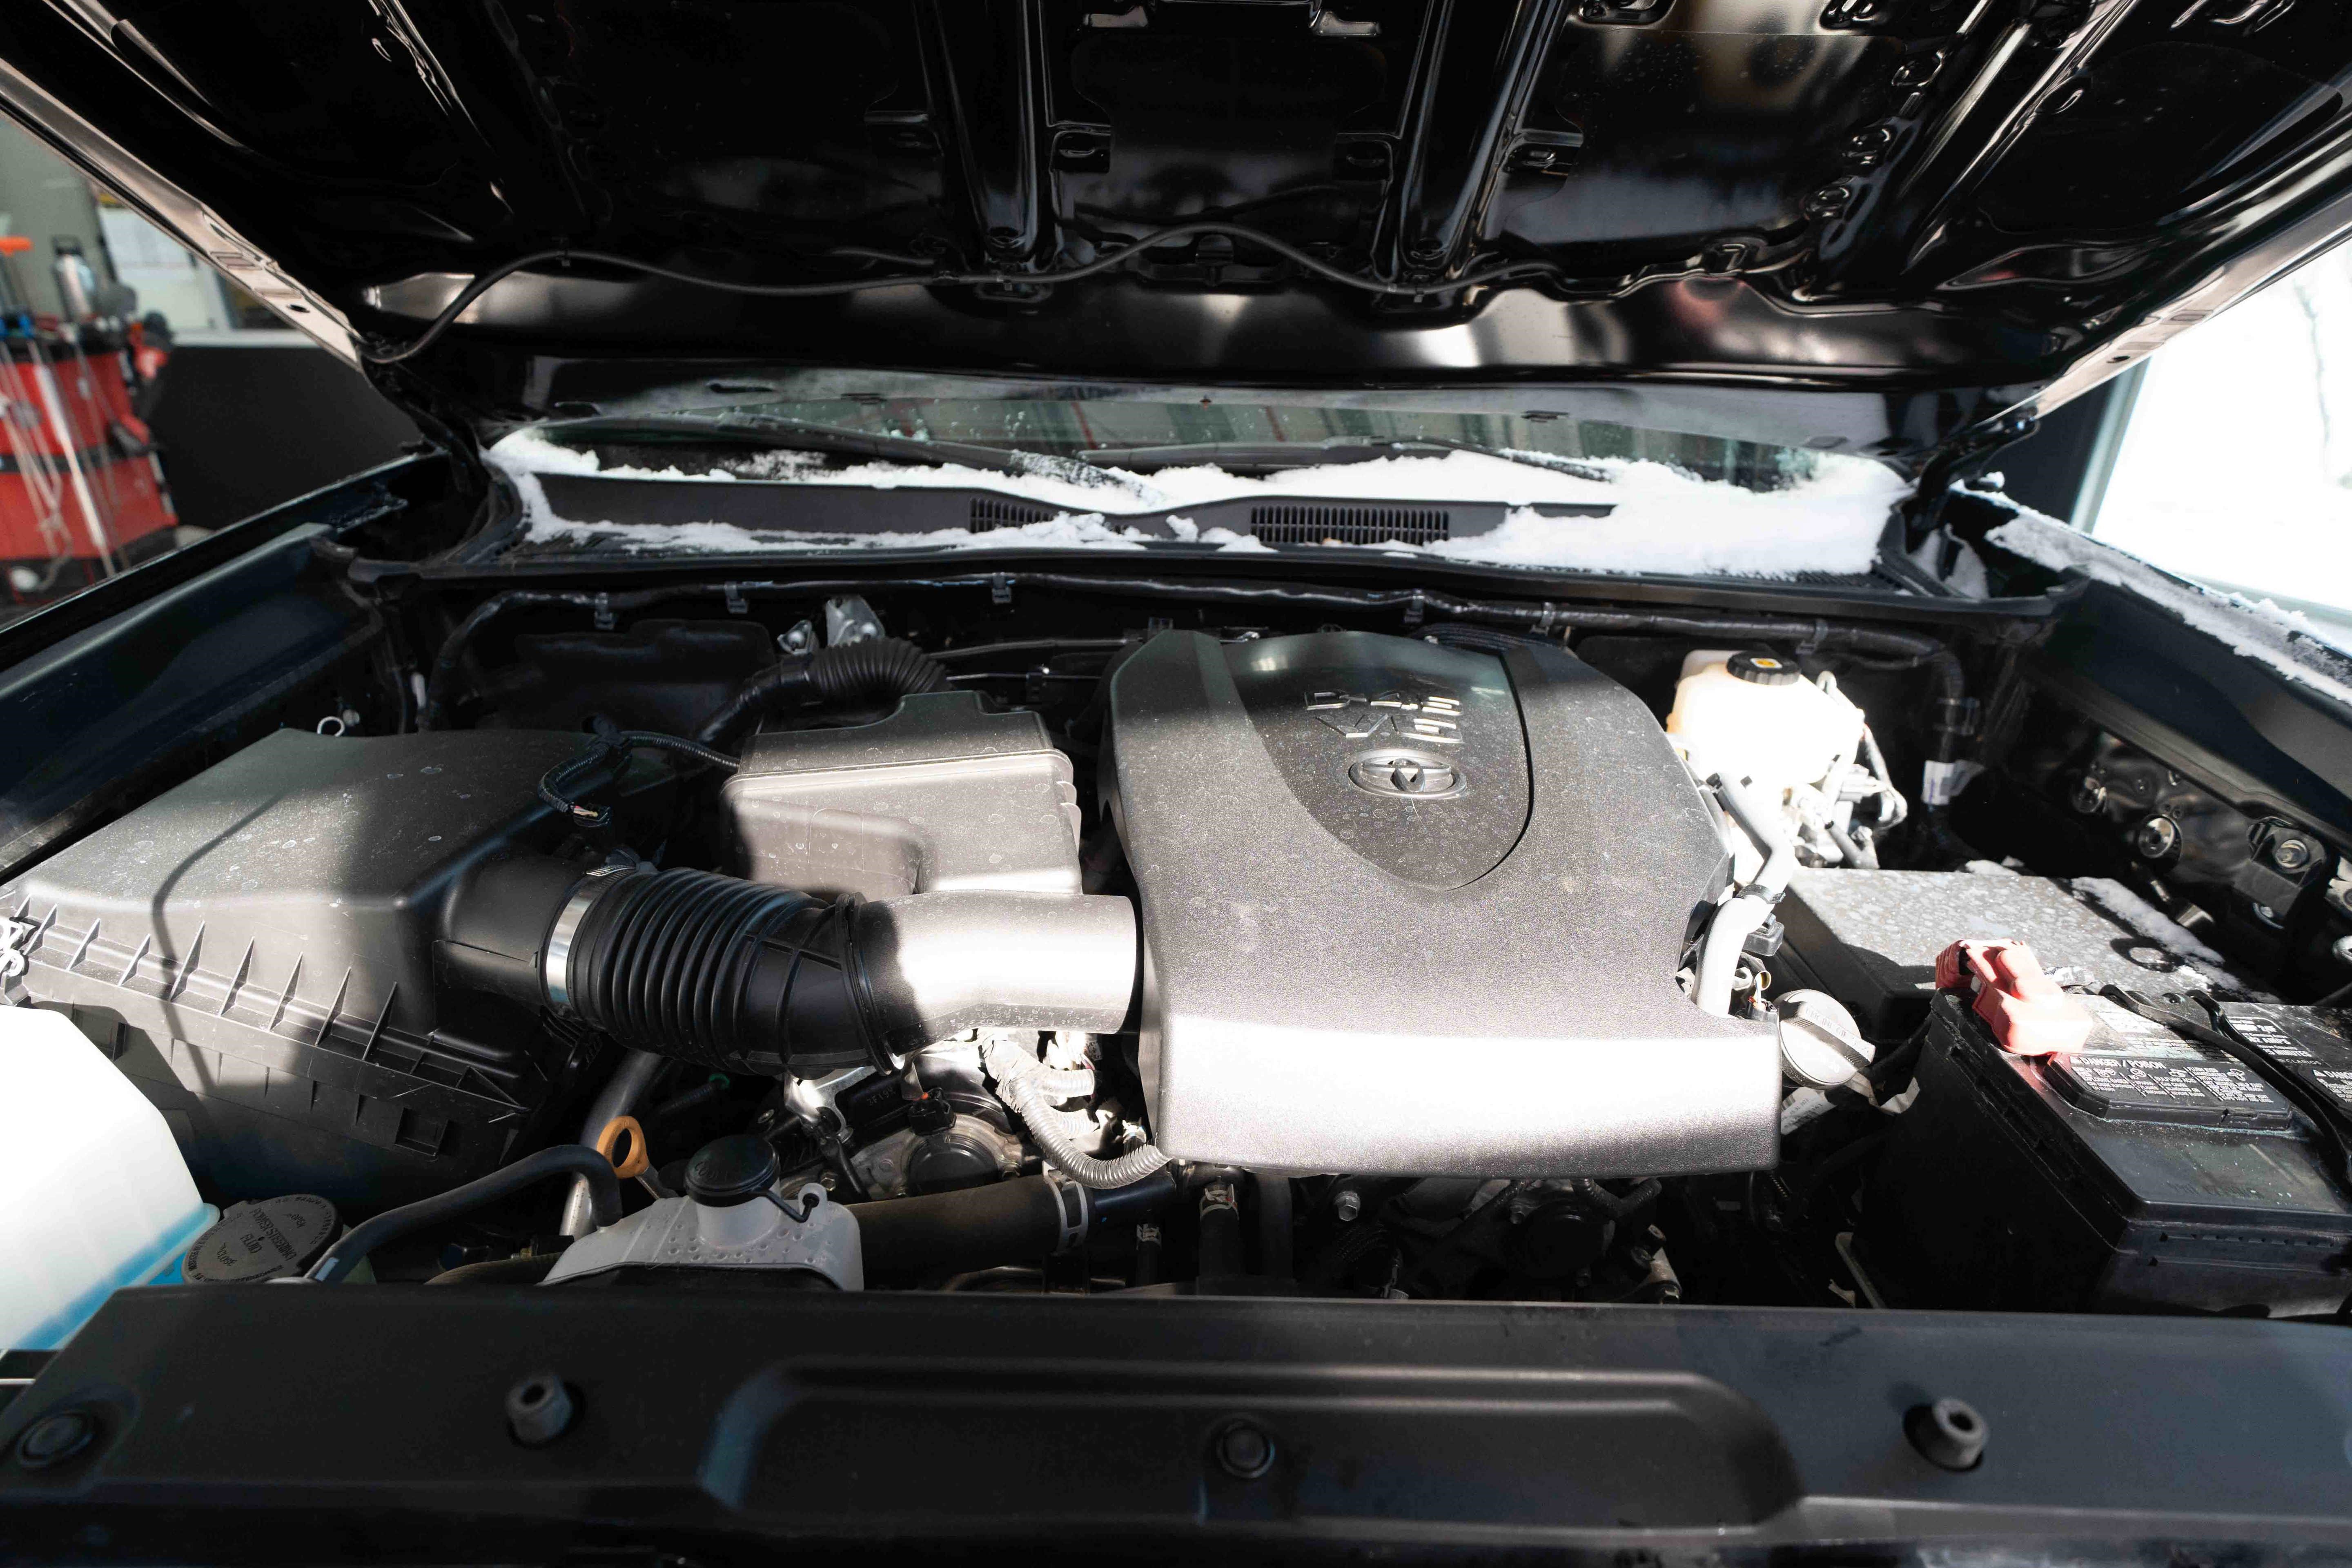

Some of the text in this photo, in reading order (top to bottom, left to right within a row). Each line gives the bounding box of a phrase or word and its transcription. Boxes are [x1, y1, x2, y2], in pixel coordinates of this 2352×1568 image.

[1304, 688, 1463, 716] D-4S
[1314, 713, 1464, 744] V6
[2274, 1049, 2313, 1057] MINUTES
[2078, 1057, 2122, 1067] DANGER
[2126, 1060, 2167, 1069] POISON
[290, 1214, 307, 1228] OPEN
[240, 1232, 263, 1254] FLUID
[249, 1208, 297, 1261] POWER STEERING
[217, 1250, 236, 1266] CLOSE
